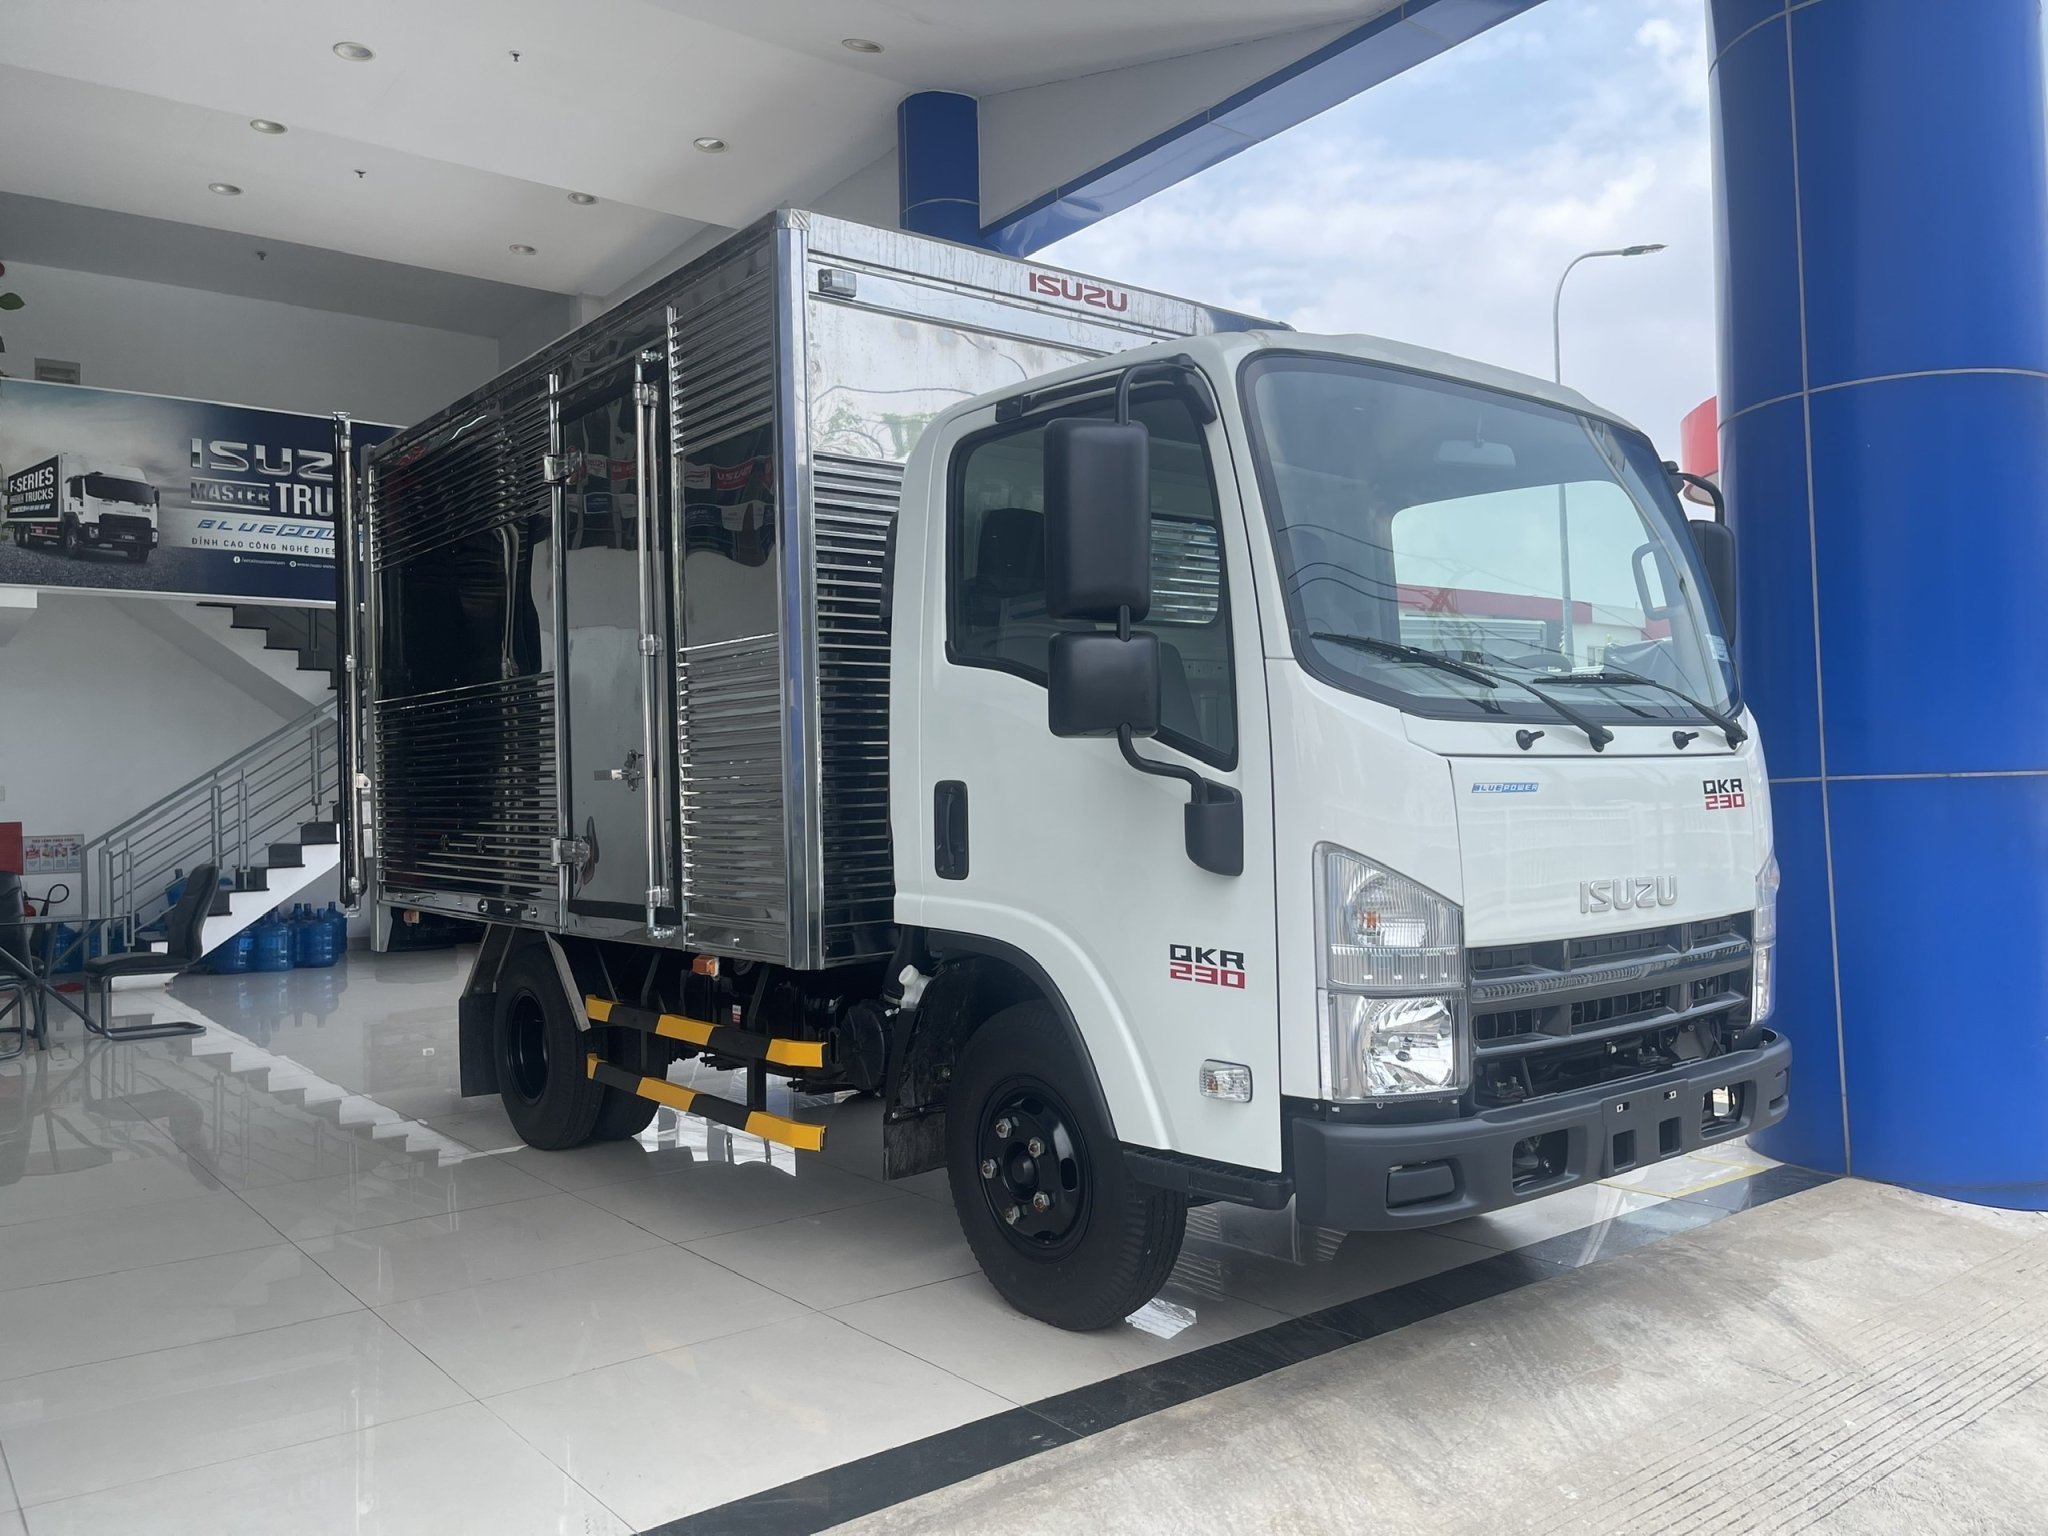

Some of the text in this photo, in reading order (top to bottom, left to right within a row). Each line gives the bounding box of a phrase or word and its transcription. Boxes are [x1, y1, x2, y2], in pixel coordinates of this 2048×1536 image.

[1029, 272, 1127, 312] ISUZU
[10, 466, 54, 493] F-SERIES
[25, 487, 54, 503] TRUCKS
[223, 540, 244, 548] CAO
[249, 540, 277, 550] CÔNG
[282, 545, 309, 553] NGHỆ
[1472, 783, 1538, 793] BLUEPOWER
[1703, 778, 1743, 794] QKR
[1706, 793, 1745, 810] 230
[1579, 874, 1678, 914] ISUZU
[1170, 944, 1245, 970] QKR
[1170, 962, 1245, 989] 230
